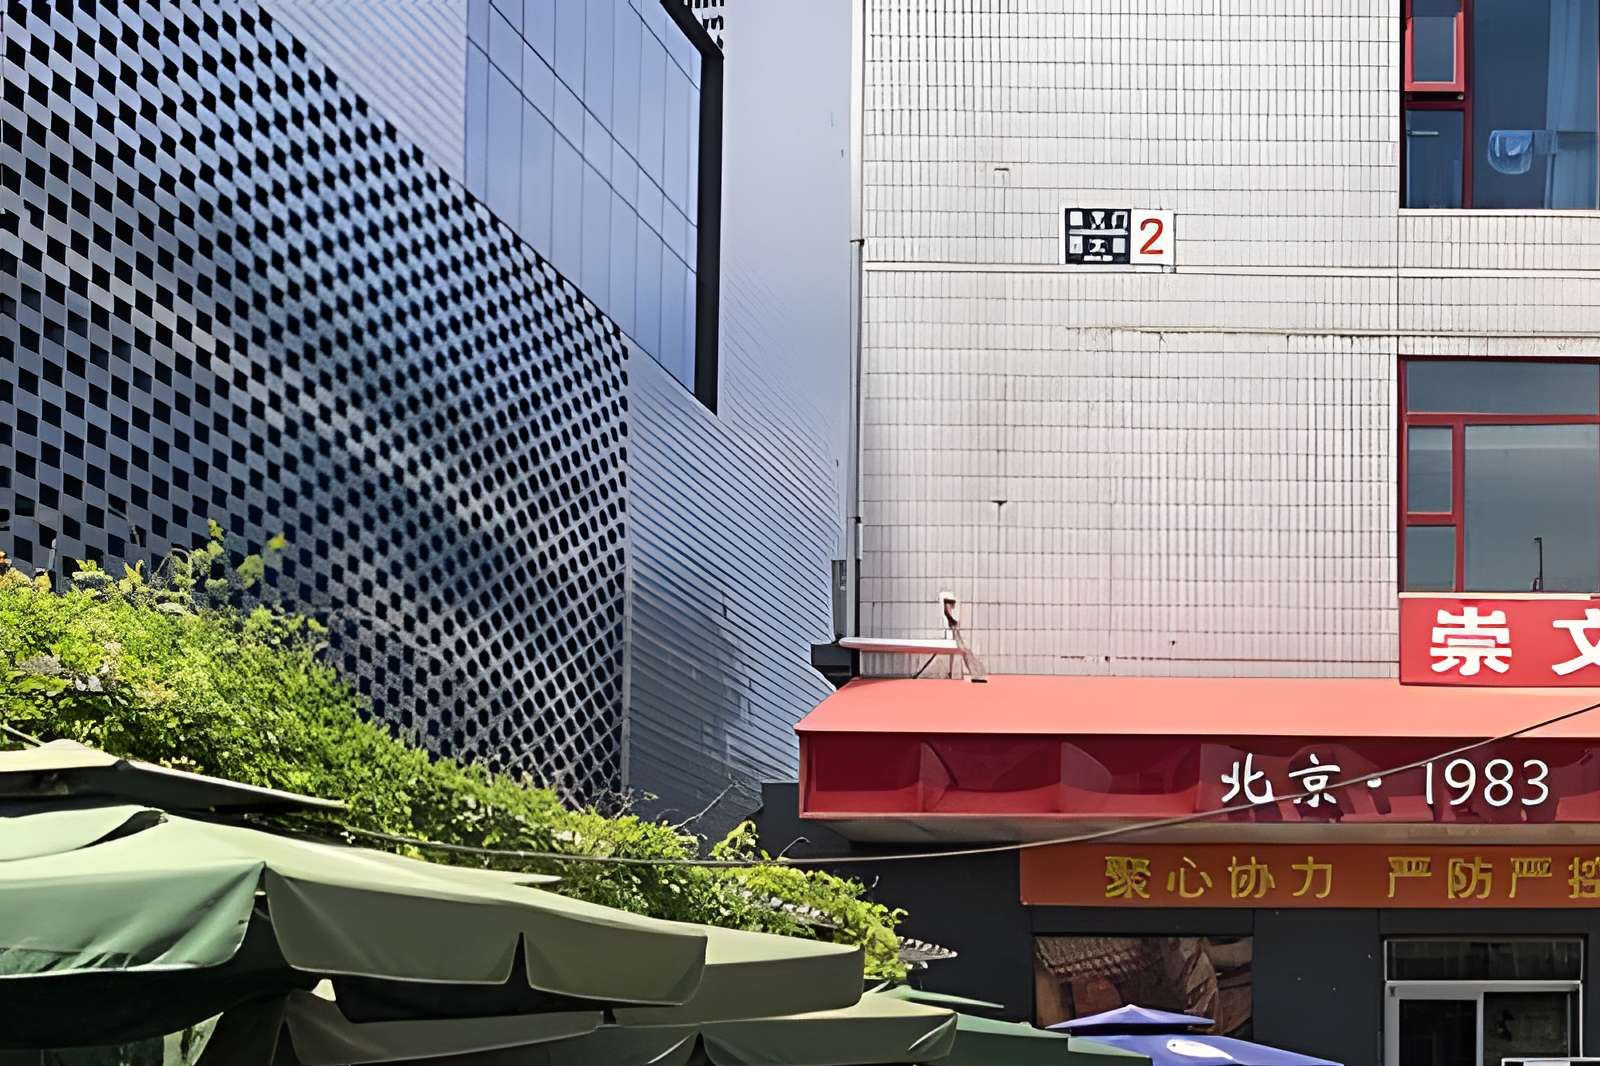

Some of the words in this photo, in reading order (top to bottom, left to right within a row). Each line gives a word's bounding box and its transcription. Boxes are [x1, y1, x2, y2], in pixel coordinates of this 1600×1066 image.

[1140, 218, 1164, 255] 2
[1105, 855, 1333, 899] 聚心协力
